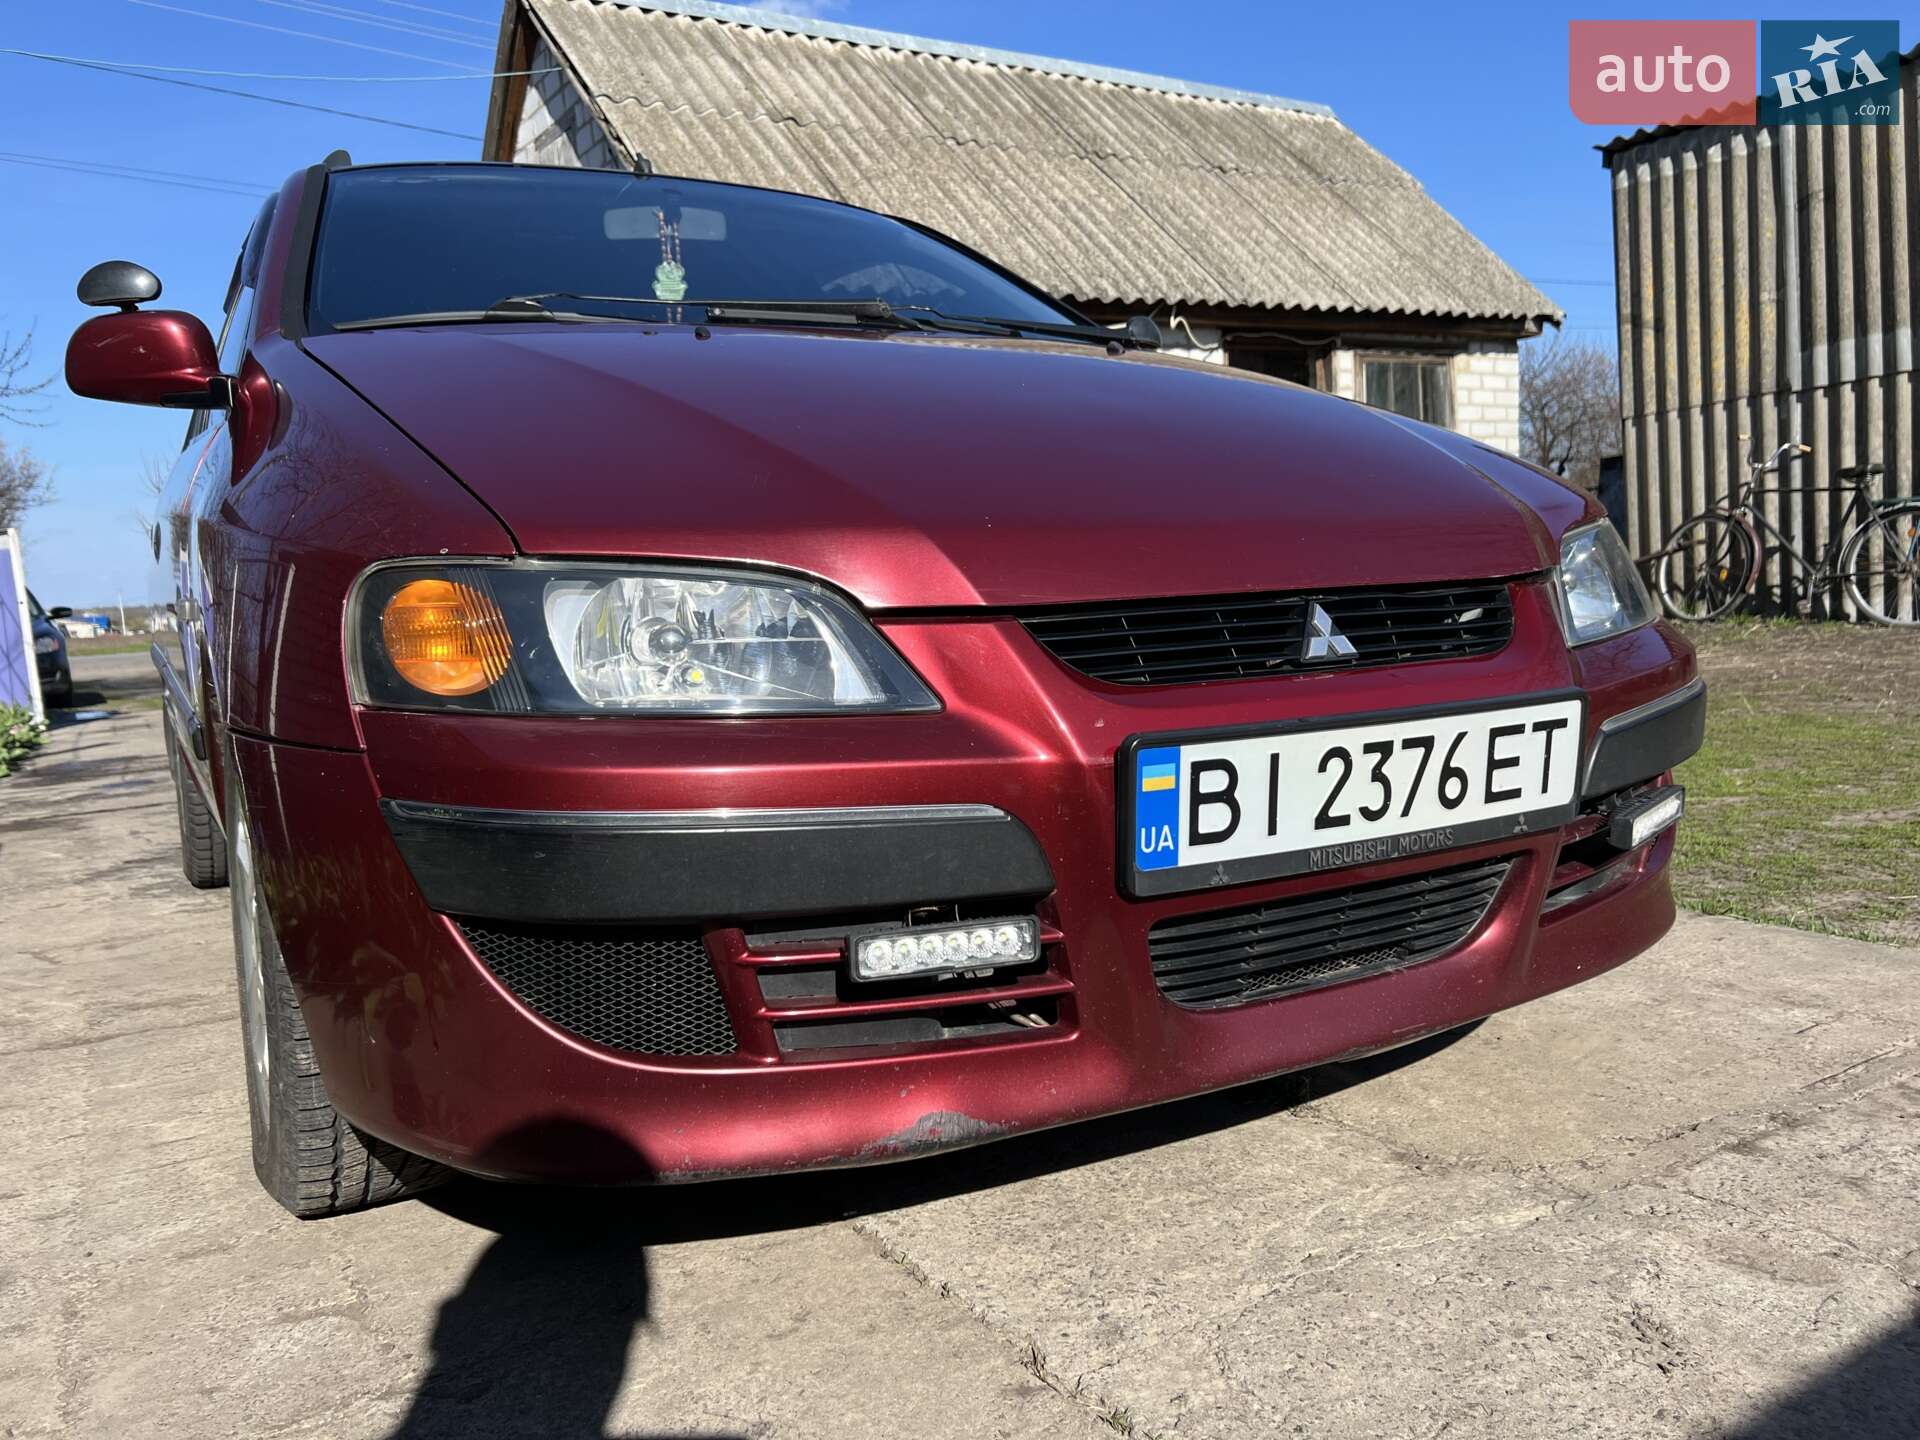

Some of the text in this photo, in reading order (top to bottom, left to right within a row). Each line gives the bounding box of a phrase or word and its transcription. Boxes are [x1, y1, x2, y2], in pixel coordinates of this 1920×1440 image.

[1188, 718, 1569, 847] BI 2376 ET
[1140, 824, 1175, 854] UA
[1308, 828, 1455, 870] MITSUBISHI MOTORS
